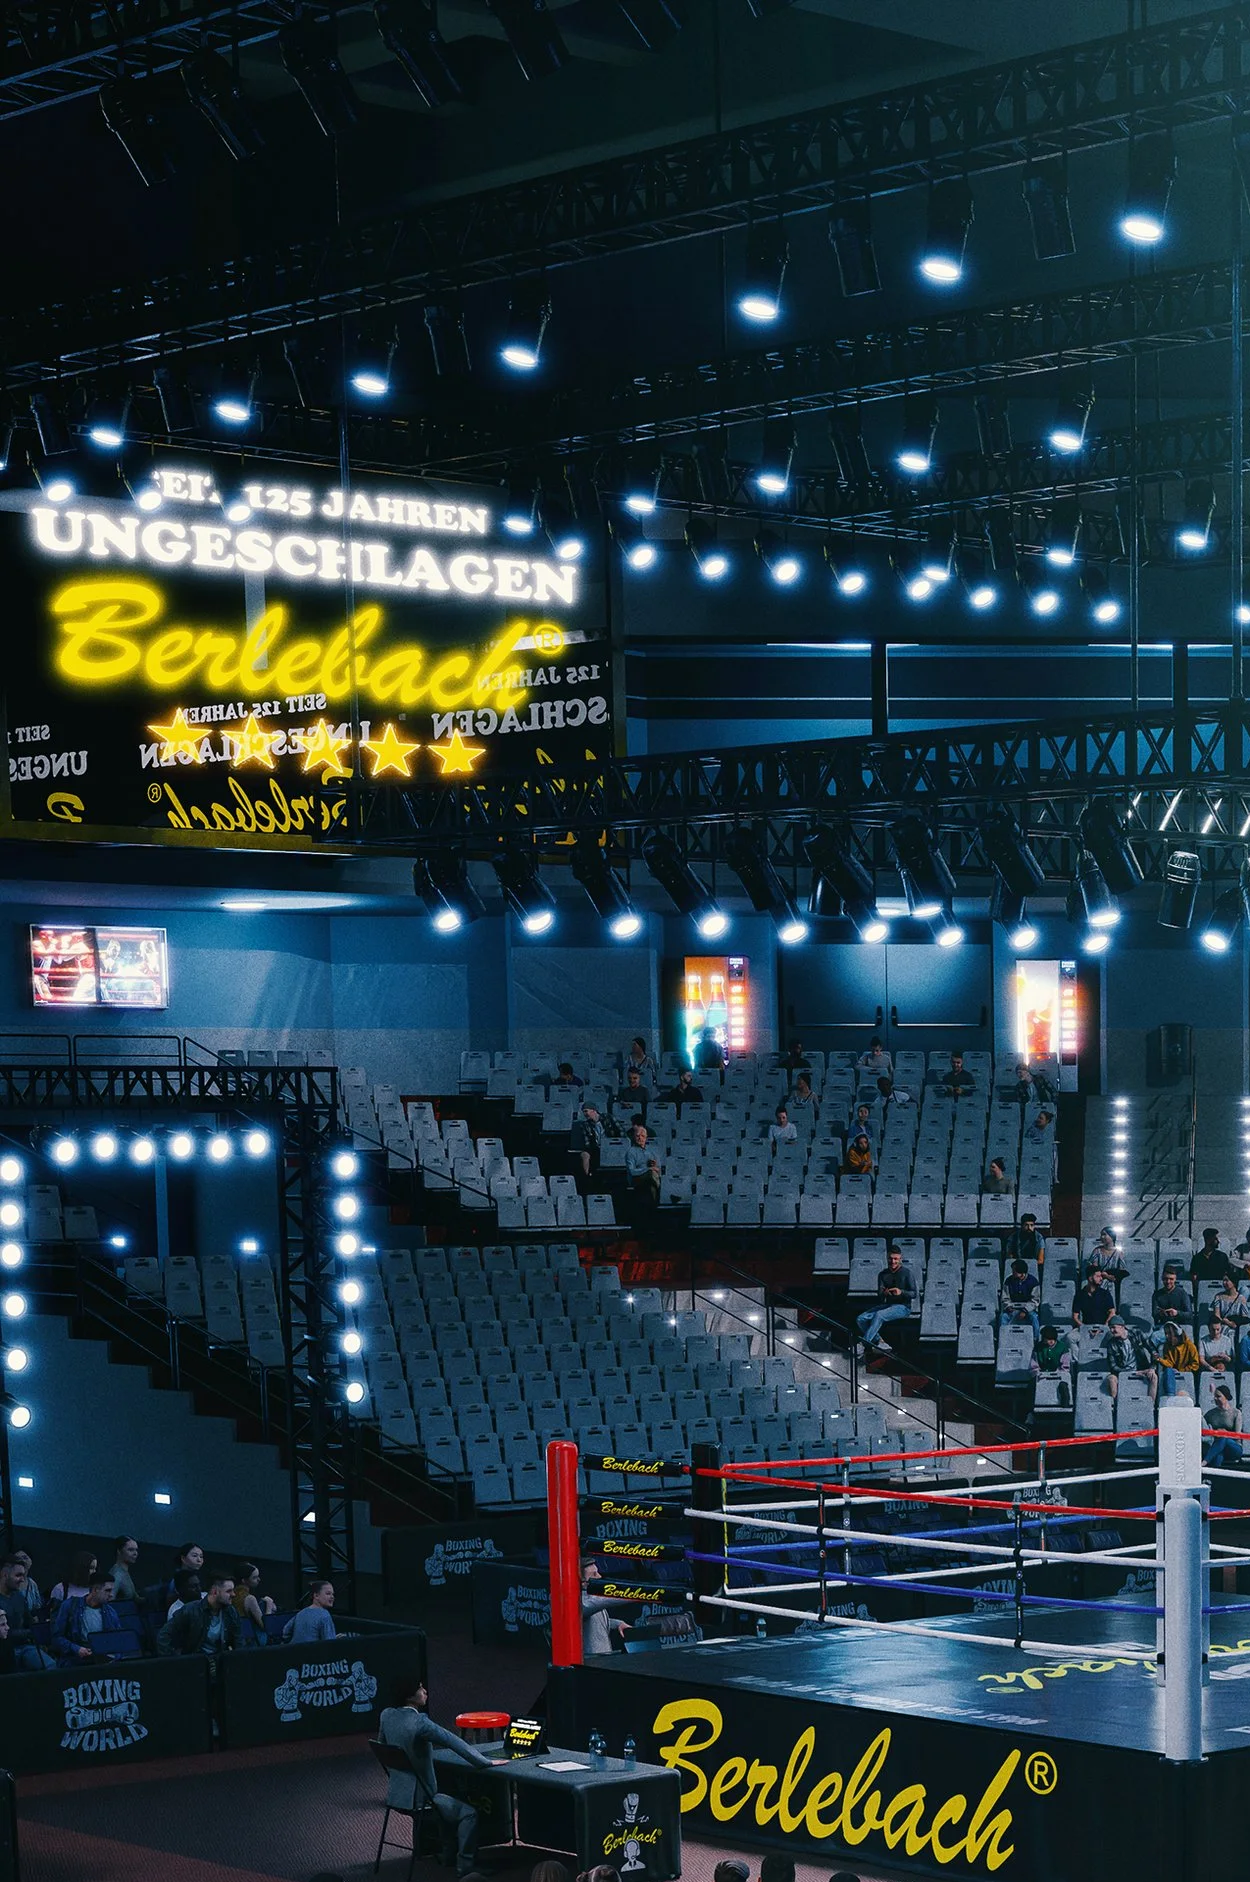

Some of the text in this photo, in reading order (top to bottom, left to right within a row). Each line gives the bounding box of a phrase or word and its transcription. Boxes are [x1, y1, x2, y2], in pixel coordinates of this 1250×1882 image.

[245, 486, 312, 517] 125
[321, 491, 488, 535] JAHREN
[31, 507, 577, 605] UNGESCHLAGEN
[300, 1658, 349, 1679] BOXING
[62, 1678, 142, 1709] BOXING
[299, 1686, 353, 1708] WORLD
[59, 1723, 149, 1752] WORLD
